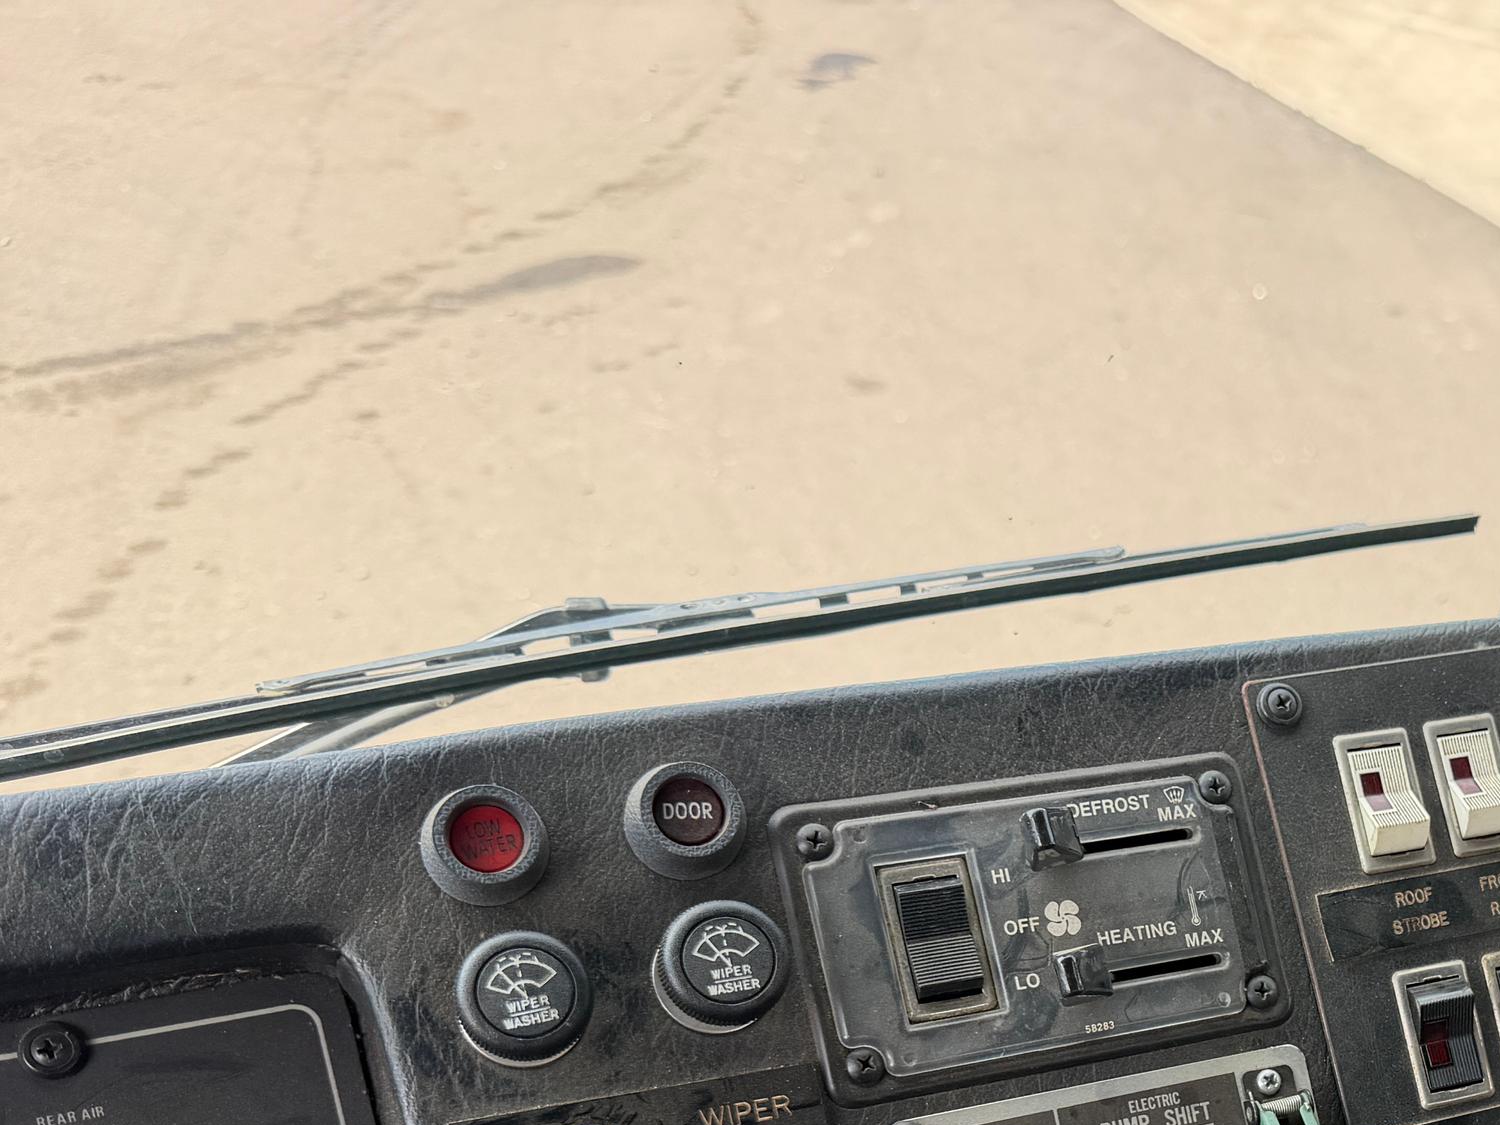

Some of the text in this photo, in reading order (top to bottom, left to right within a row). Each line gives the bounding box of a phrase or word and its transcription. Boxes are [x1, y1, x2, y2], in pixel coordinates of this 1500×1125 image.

[662, 802, 713, 820] DOOR
[1068, 794, 1150, 819] DEFROST
[1157, 803, 1197, 822] MAX
[465, 818, 500, 839] LOW
[463, 833, 518, 861] WATER
[991, 868, 1011, 885] HI
[1394, 886, 1433, 908] ROOF
[1003, 917, 1040, 937] OFF
[1391, 910, 1450, 936] STROBE
[1097, 921, 1177, 947] HEATING
[1185, 928, 1224, 948] MAX
[710, 965, 752, 981] WIPER
[1015, 973, 1041, 992] LO
[707, 979, 761, 996] WASHER
[506, 995, 550, 1013] WIPER
[503, 1009, 560, 1030] WASHER
[1084, 1020, 1116, 1035] 58283
[82, 1105, 105, 1121] AIR
[1128, 1092, 1181, 1114] ELECTRIC
